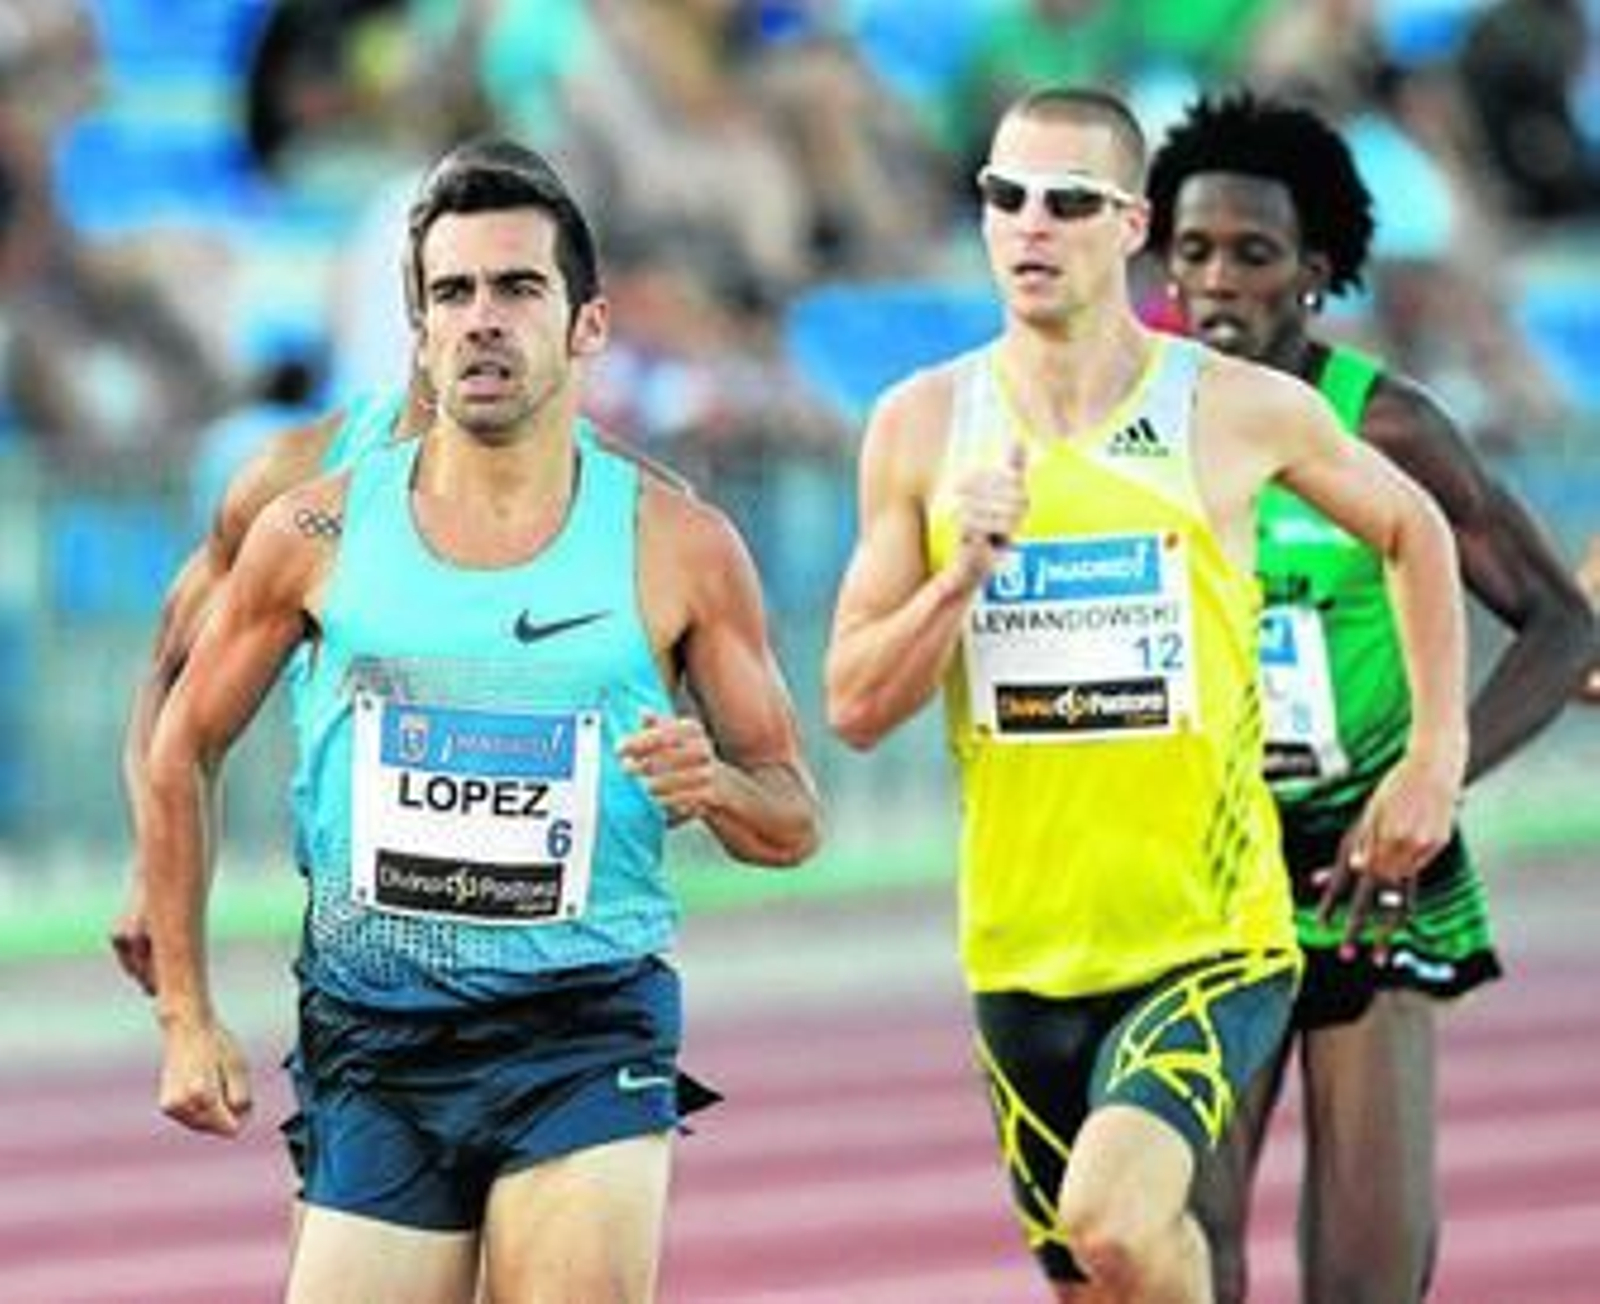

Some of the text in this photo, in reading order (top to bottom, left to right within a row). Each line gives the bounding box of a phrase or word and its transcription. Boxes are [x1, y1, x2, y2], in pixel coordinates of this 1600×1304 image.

[972, 602, 1179, 634] LEWANDOWSKI
[1134, 633, 1184, 671] 12
[398, 771, 549, 819] LOPEZ
[547, 820, 573, 859] 6
